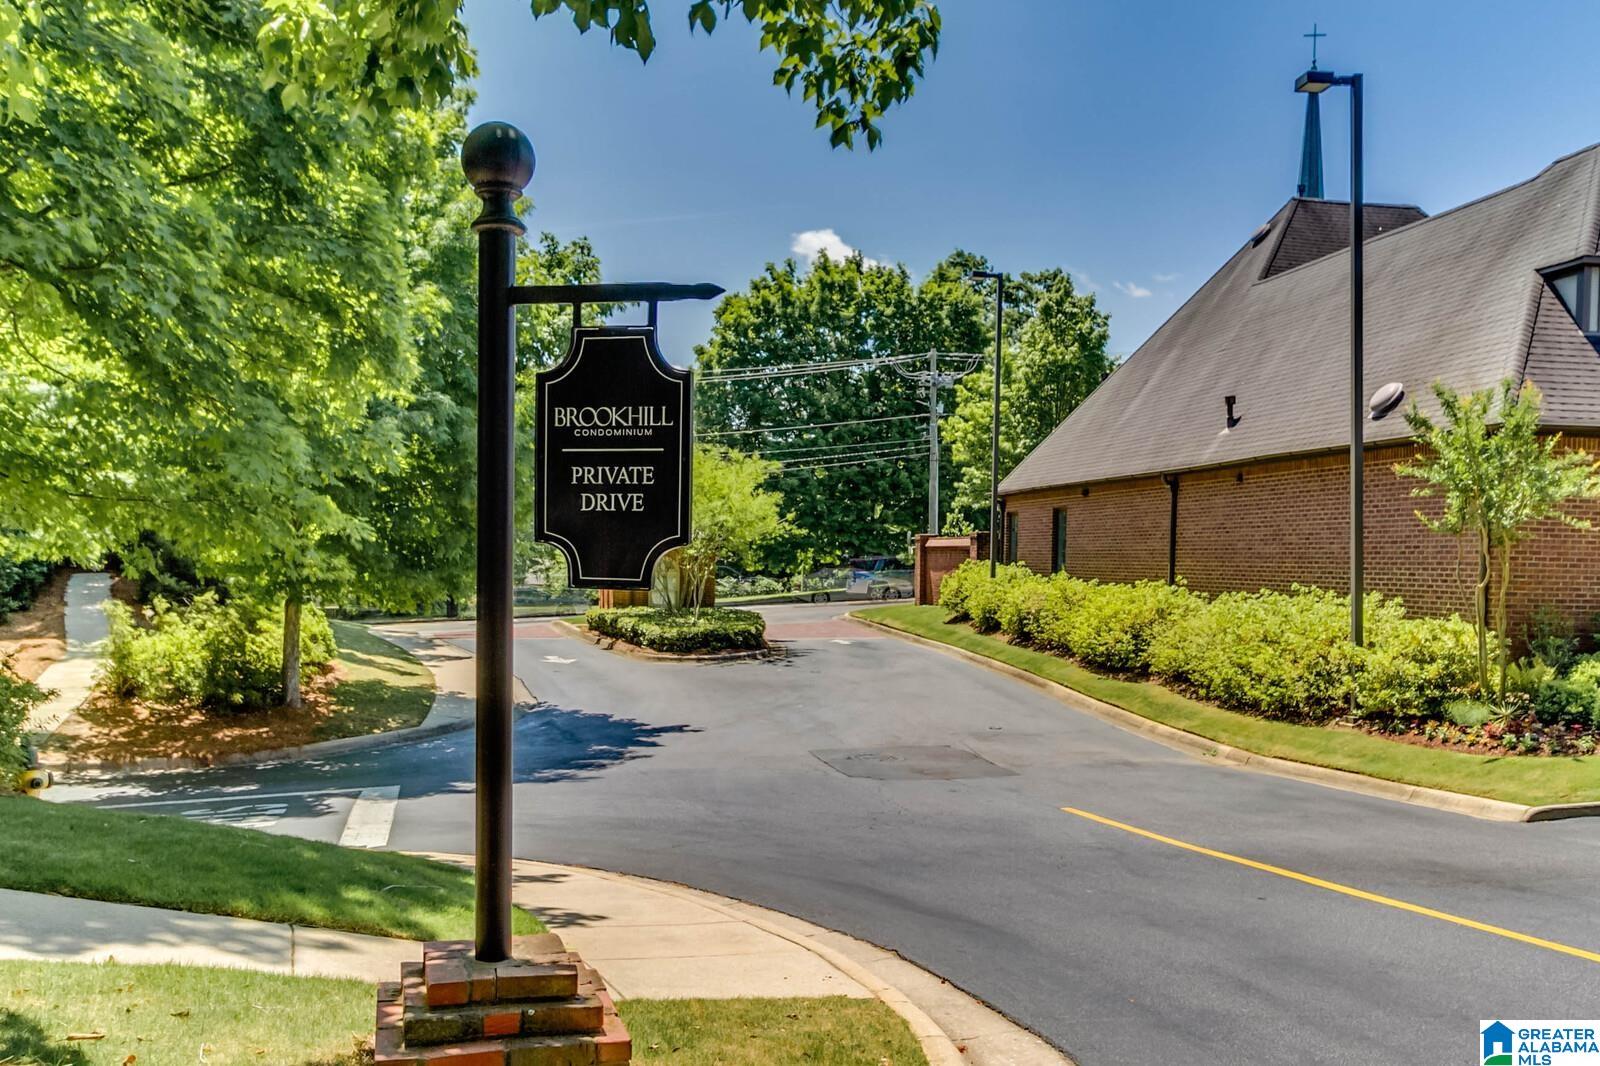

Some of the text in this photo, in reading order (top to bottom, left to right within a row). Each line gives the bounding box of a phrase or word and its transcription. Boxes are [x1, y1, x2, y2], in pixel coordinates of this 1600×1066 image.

[554, 406, 674, 427] BROOKHILL
[573, 428, 653, 437] CONDOMINIUM
[571, 466, 655, 485] PRIVATE
[580, 493, 645, 512] DRIVE
